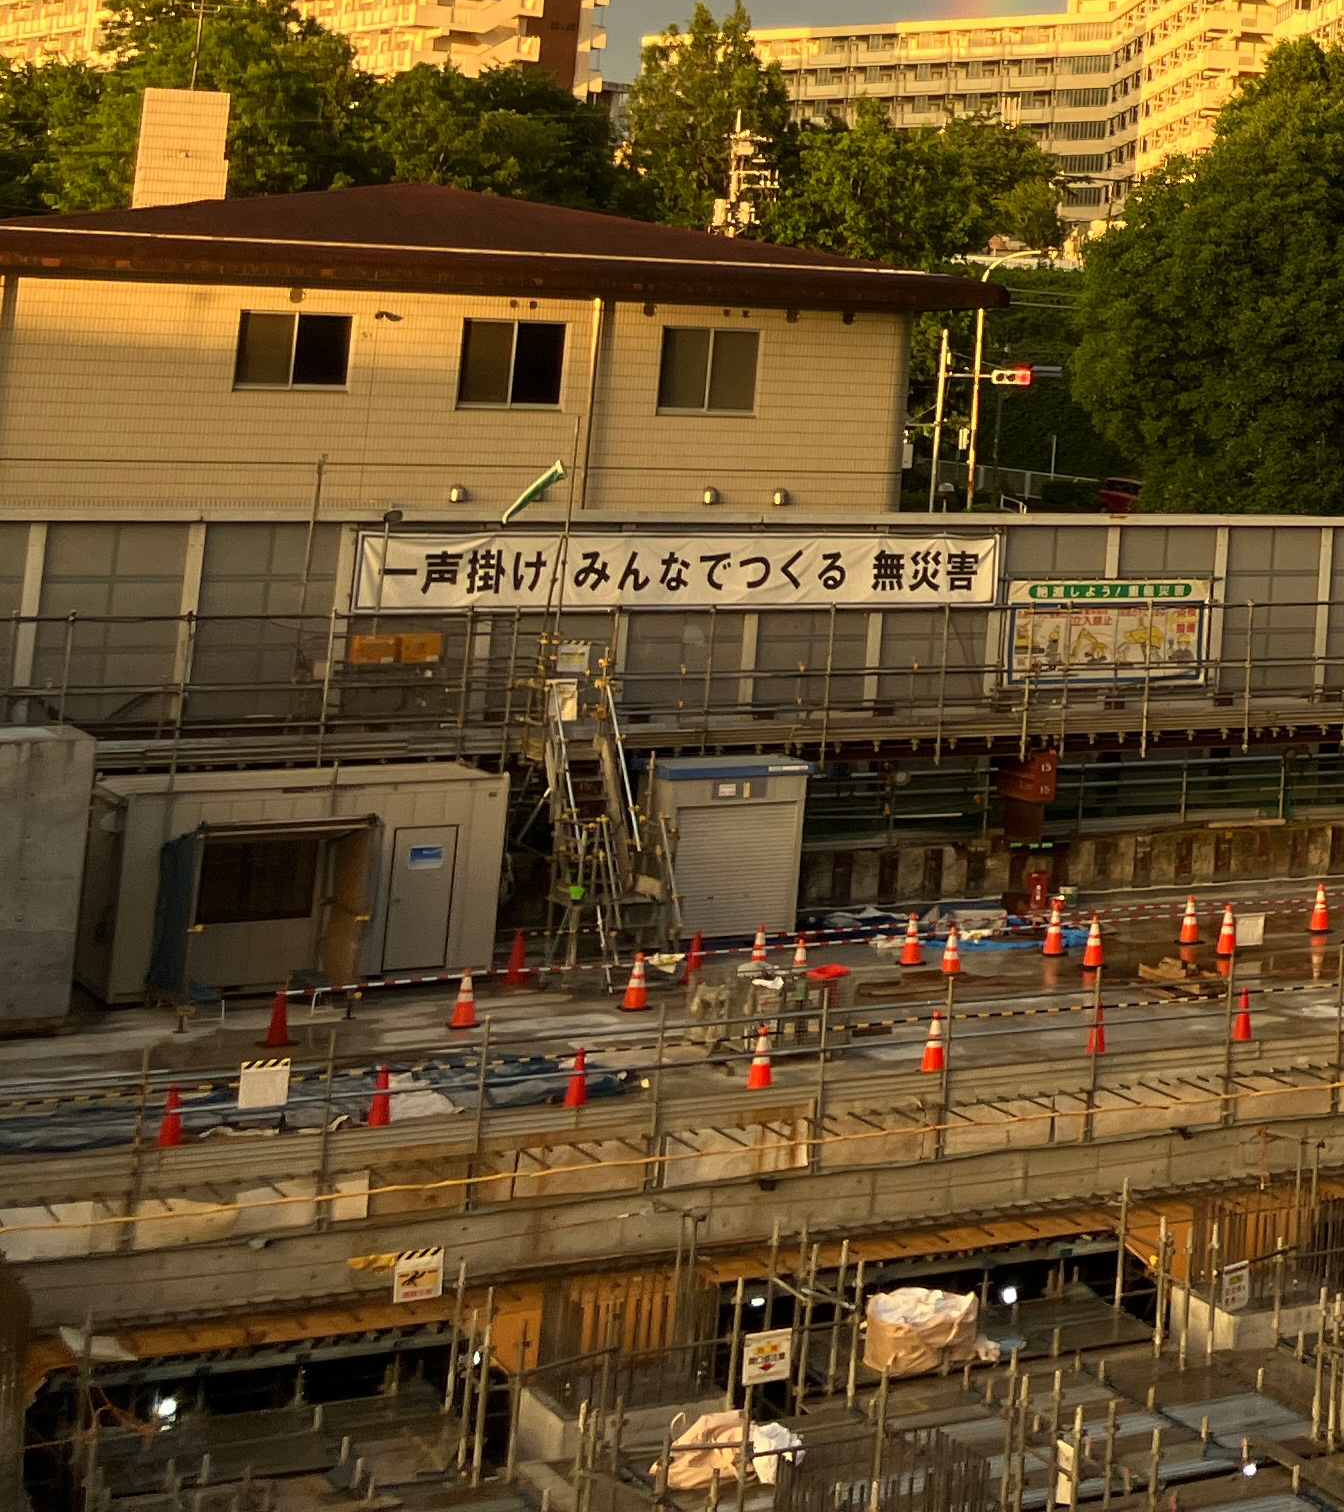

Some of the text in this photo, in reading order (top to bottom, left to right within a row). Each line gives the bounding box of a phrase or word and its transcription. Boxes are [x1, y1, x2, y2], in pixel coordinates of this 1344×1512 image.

[379, 549, 980, 594] 一声掛け みんなでつくる 無災害
[1071, 615, 1113, 627] 立入禁止
